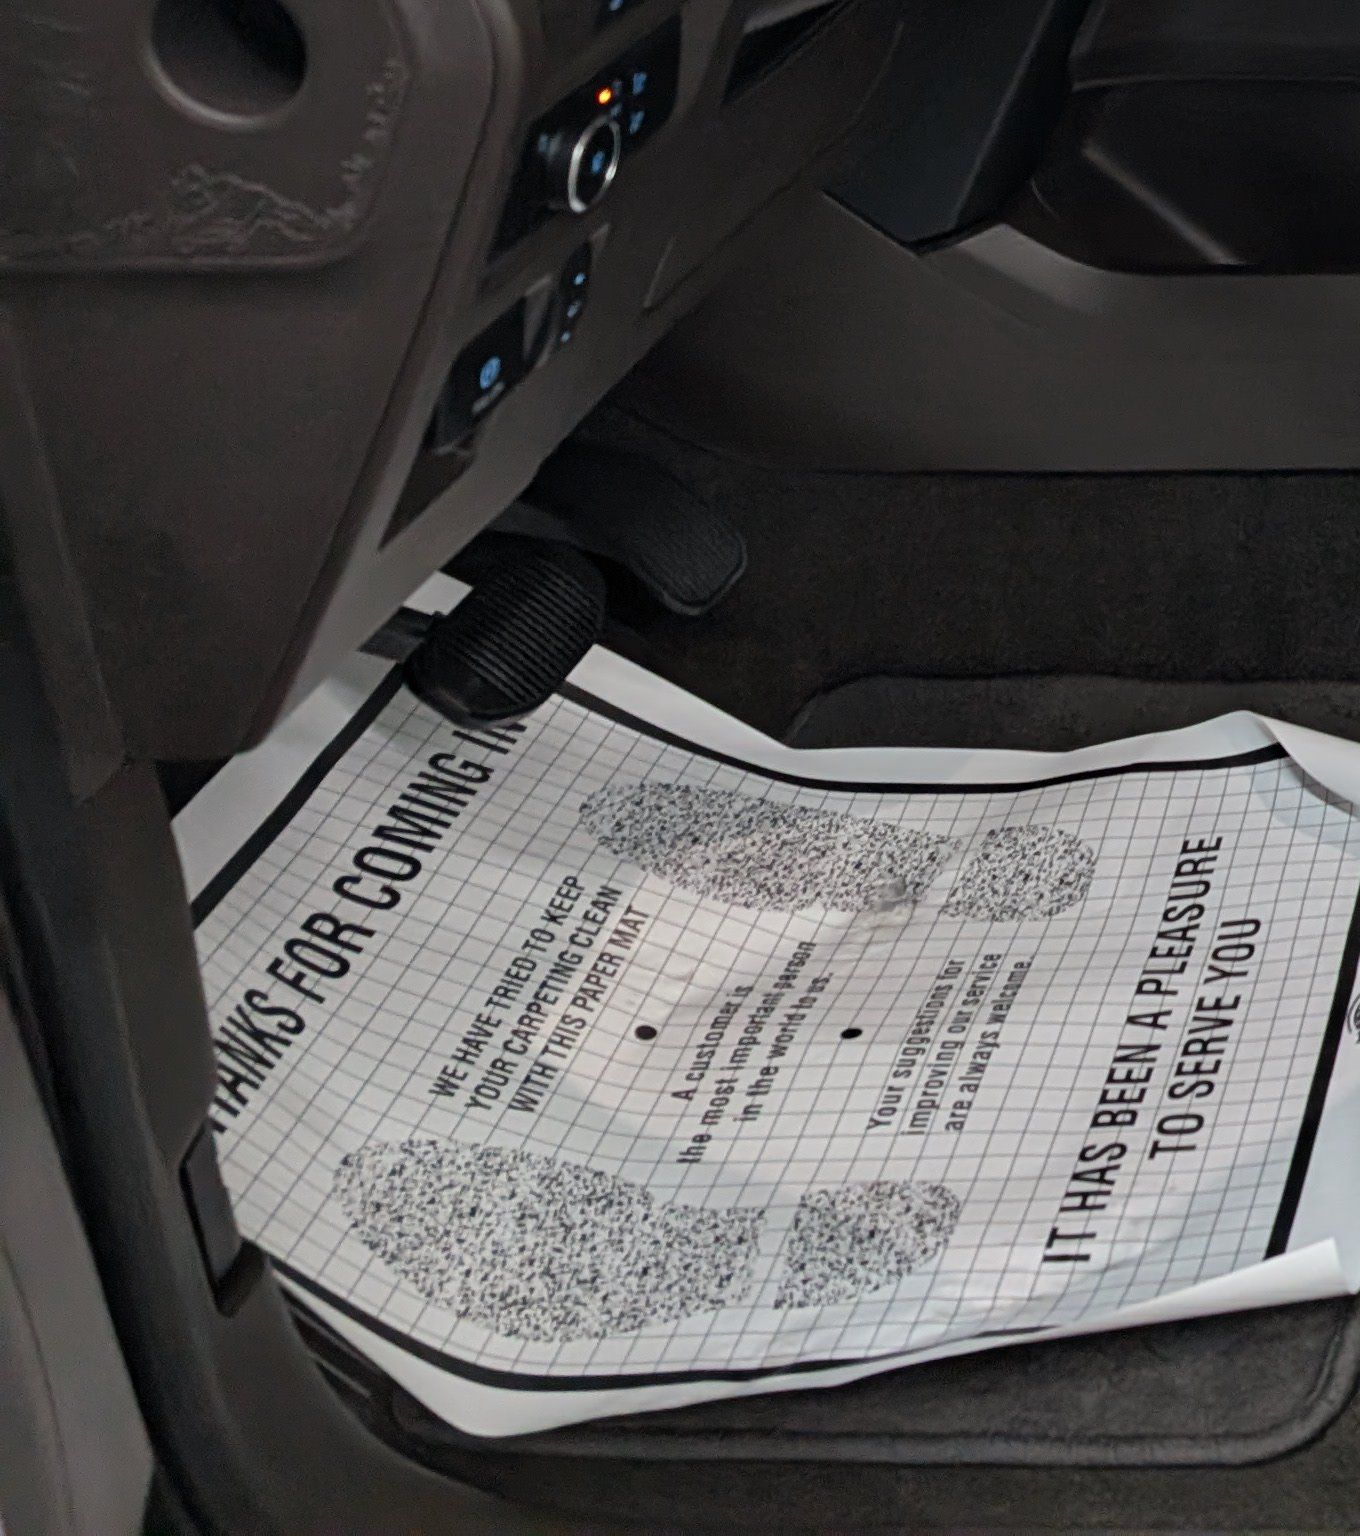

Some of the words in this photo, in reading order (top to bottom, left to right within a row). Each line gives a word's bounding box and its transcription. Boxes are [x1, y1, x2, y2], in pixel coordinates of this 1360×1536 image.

[266, 911, 376, 1004] FOR
[332, 752, 494, 911] COMING
[1135, 836, 1223, 996] PLEASURE
[428, 1065, 468, 1098] WE
[452, 1013, 503, 1065] HAVE
[484, 956, 537, 1010] TRIED
[521, 927, 556, 953] TO
[540, 875, 585, 926] KEEP
[1203, 918, 1261, 985] YOU
[464, 1058, 519, 1111] YOUR
[503, 949, 584, 1056] CARPETING
[569, 885, 623, 949] CLEAN
[507, 1060, 559, 1113] WITH
[541, 1014, 587, 1060] THIS
[571, 951, 625, 1013] PAPER
[608, 905, 650, 951] MAT
[767, 1013, 806, 1060] world
[790, 996, 818, 1010] to
[1127, 1009, 1173, 1031] A
[671, 1088, 697, 1101] A
[685, 1000, 741, 1082] customer
[726, 985, 753, 998] is
[676, 1133, 712, 1164] the
[701, 1078, 739, 1126] most
[720, 992, 785, 1071] important
[773, 940, 817, 991] person
[746, 1066, 779, 1097] the
[866, 1085, 905, 1131] Your
[892, 983, 953, 1079] suggestions
[937, 959, 965, 981] for
[900, 1040, 965, 1135] improving
[947, 1010, 973, 1034] our
[961, 953, 1003, 1008] service
[958, 1030, 1000, 1093] always
[1168, 994, 1241, 1100] SERVE
[733, 1104, 763, 1122] in
[945, 1100, 973, 1132] are
[1090, 1043, 1162, 1129] BEEN
[1148, 1112, 1206, 1161] TO
[1058, 1141, 1128, 1213] HAS
[1042, 1227, 1097, 1262] IT
